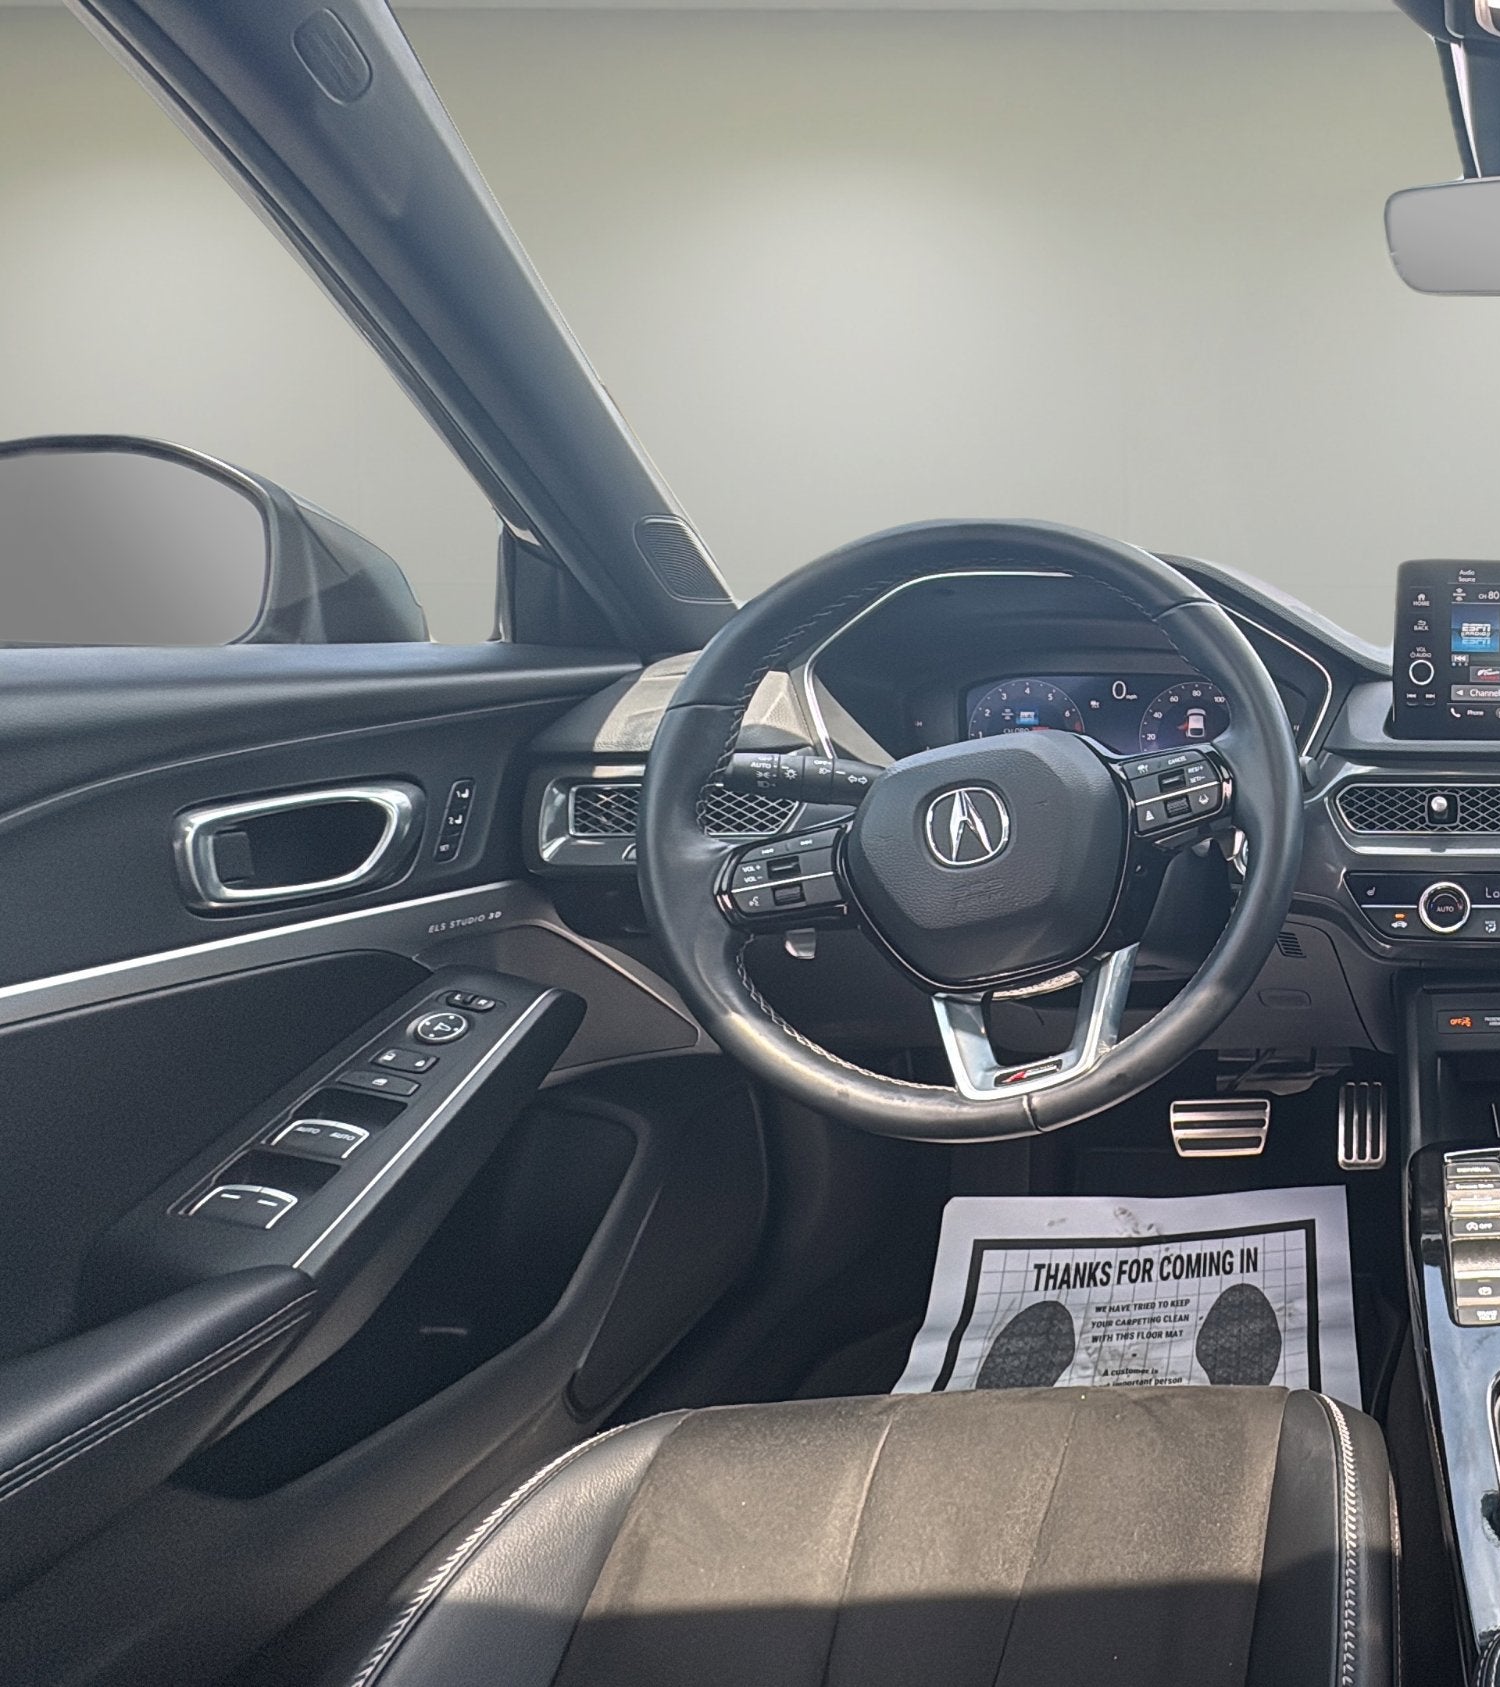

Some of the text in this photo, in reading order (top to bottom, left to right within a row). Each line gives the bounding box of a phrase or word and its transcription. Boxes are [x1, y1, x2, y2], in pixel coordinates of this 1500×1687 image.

[1488, 591, 1500, 600] 80
[1462, 623, 1491, 632] ESPN
[1024, 687, 1030, 695] 4
[1112, 680, 1126, 699] 0
[1469, 687, 1500, 697] Channel
[1001, 693, 1007, 701] 3
[1047, 693, 1053, 701] 5
[1169, 695, 1179, 703] 60
[985, 708, 991, 717] 2
[1064, 710, 1070, 718] 6
[1153, 711, 1163, 719] 40
[1146, 733, 1156, 741] 20
[750, 761, 771, 769] AUTO
[448, 816, 454, 825] 2
[1485, 887, 1500, 899] Lo
[428, 922, 447, 934] ELS
[449, 914, 486, 929] STUDIO
[295, 1126, 320, 1135] AUTO
[329, 1131, 356, 1141] AUTO
[1033, 1247, 1259, 1291] THANKS FOR COMING IN
[1095, 1299, 1191, 1313] WE HAVE TRIED TO KEEP
[1091, 1314, 1190, 1329] YOUR CARPETING CLEAN
[1091, 1329, 1183, 1343] WITH THIS FLOOR MAT
[1102, 1367, 1159, 1376] A customer is
[1154, 1377, 1183, 1386] person
